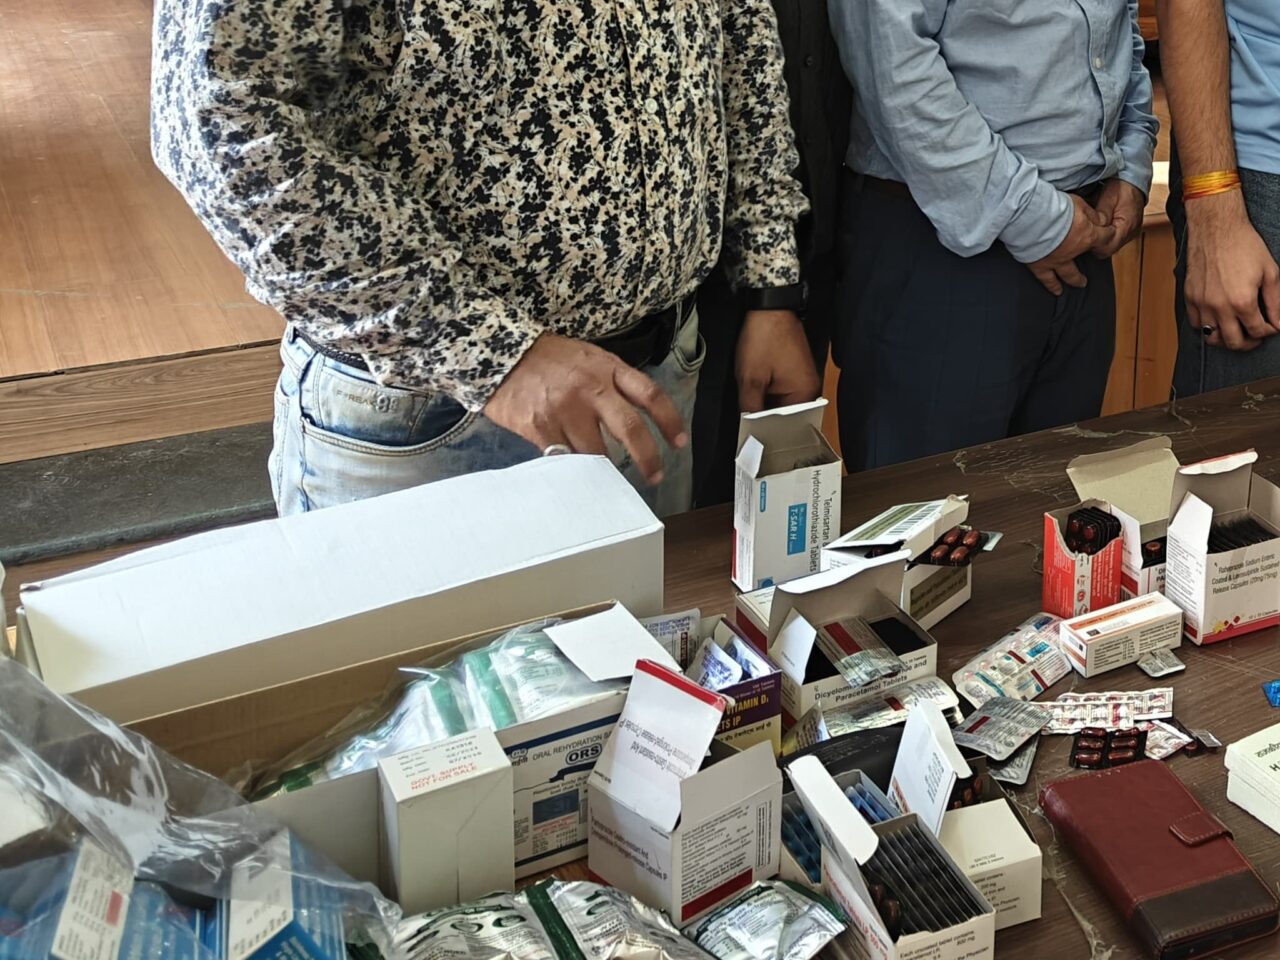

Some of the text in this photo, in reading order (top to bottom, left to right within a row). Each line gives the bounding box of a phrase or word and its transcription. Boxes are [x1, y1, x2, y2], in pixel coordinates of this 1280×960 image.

[790, 507, 798, 533] T-SAR
[810, 470, 821, 572] Hydrochlorothiazide Tablets
[822, 497, 832, 541] Telmisartan
[1212, 574, 1228, 585] Coated
[1213, 584, 1229, 595] Release
[913, 660, 927, 669] and
[836, 675, 908, 702] Paracetamol Tablets
[726, 696, 759, 715] VITAMIN
[733, 716, 741, 727] IP
[532, 749, 552, 760] ORAL
[553, 734, 602, 753] REHYDRATION
[568, 744, 600, 762] ORS
[440, 763, 474, 777] SUPPLY
[1269, 763, 1280, 772] H
[411, 766, 477, 790] NOT FOR SALE
[900, 950, 913, 959] Each
